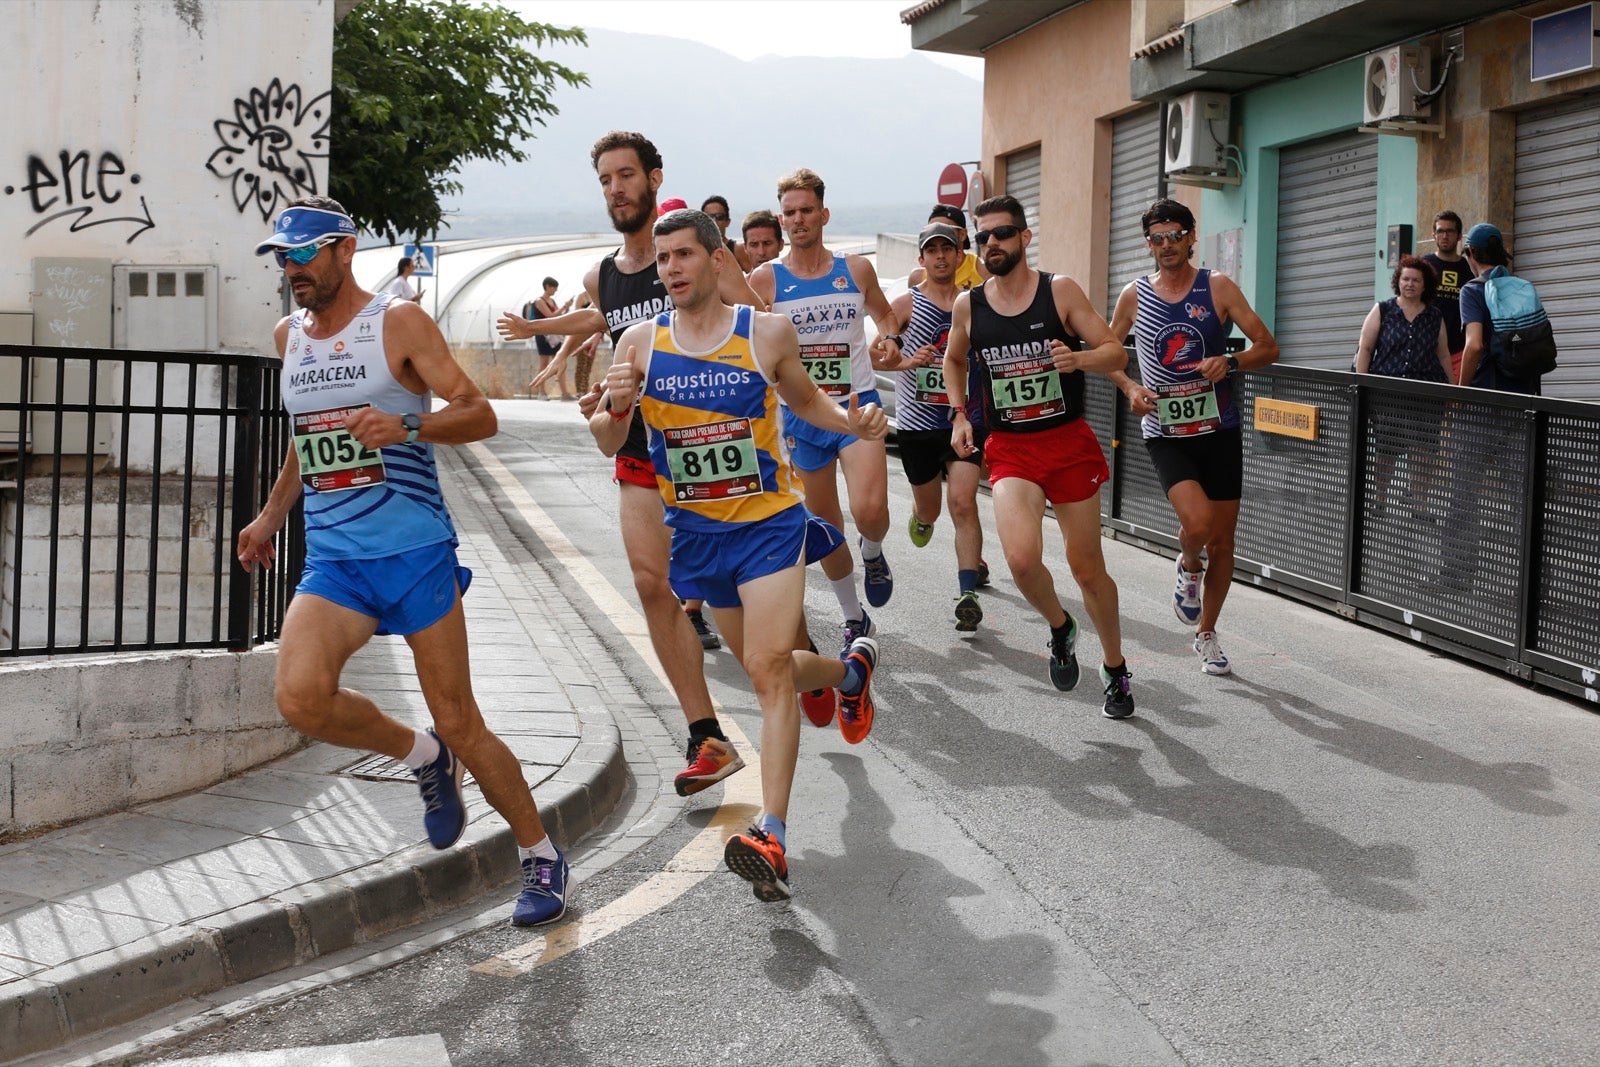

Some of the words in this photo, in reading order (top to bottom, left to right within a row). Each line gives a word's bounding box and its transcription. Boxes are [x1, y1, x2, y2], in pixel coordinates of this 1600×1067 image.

[606, 295, 674, 327] GRANADA
[790, 306, 811, 314] CLUB
[814, 303, 857, 311] ATLETISMO
[792, 309, 857, 325] CAXAR
[981, 339, 1053, 361] GRANADA
[289, 365, 367, 388] MARACENA
[801, 361, 842, 380] 735
[655, 369, 750, 395] agustinos
[1004, 376, 1050, 402] 157
[669, 388, 736, 402] GRANADA
[1168, 396, 1207, 420] 987
[681, 428, 697, 438] GRAN
[697, 425, 718, 436] PREMIO
[720, 424, 727, 432] DE
[682, 445, 743, 478] 819
